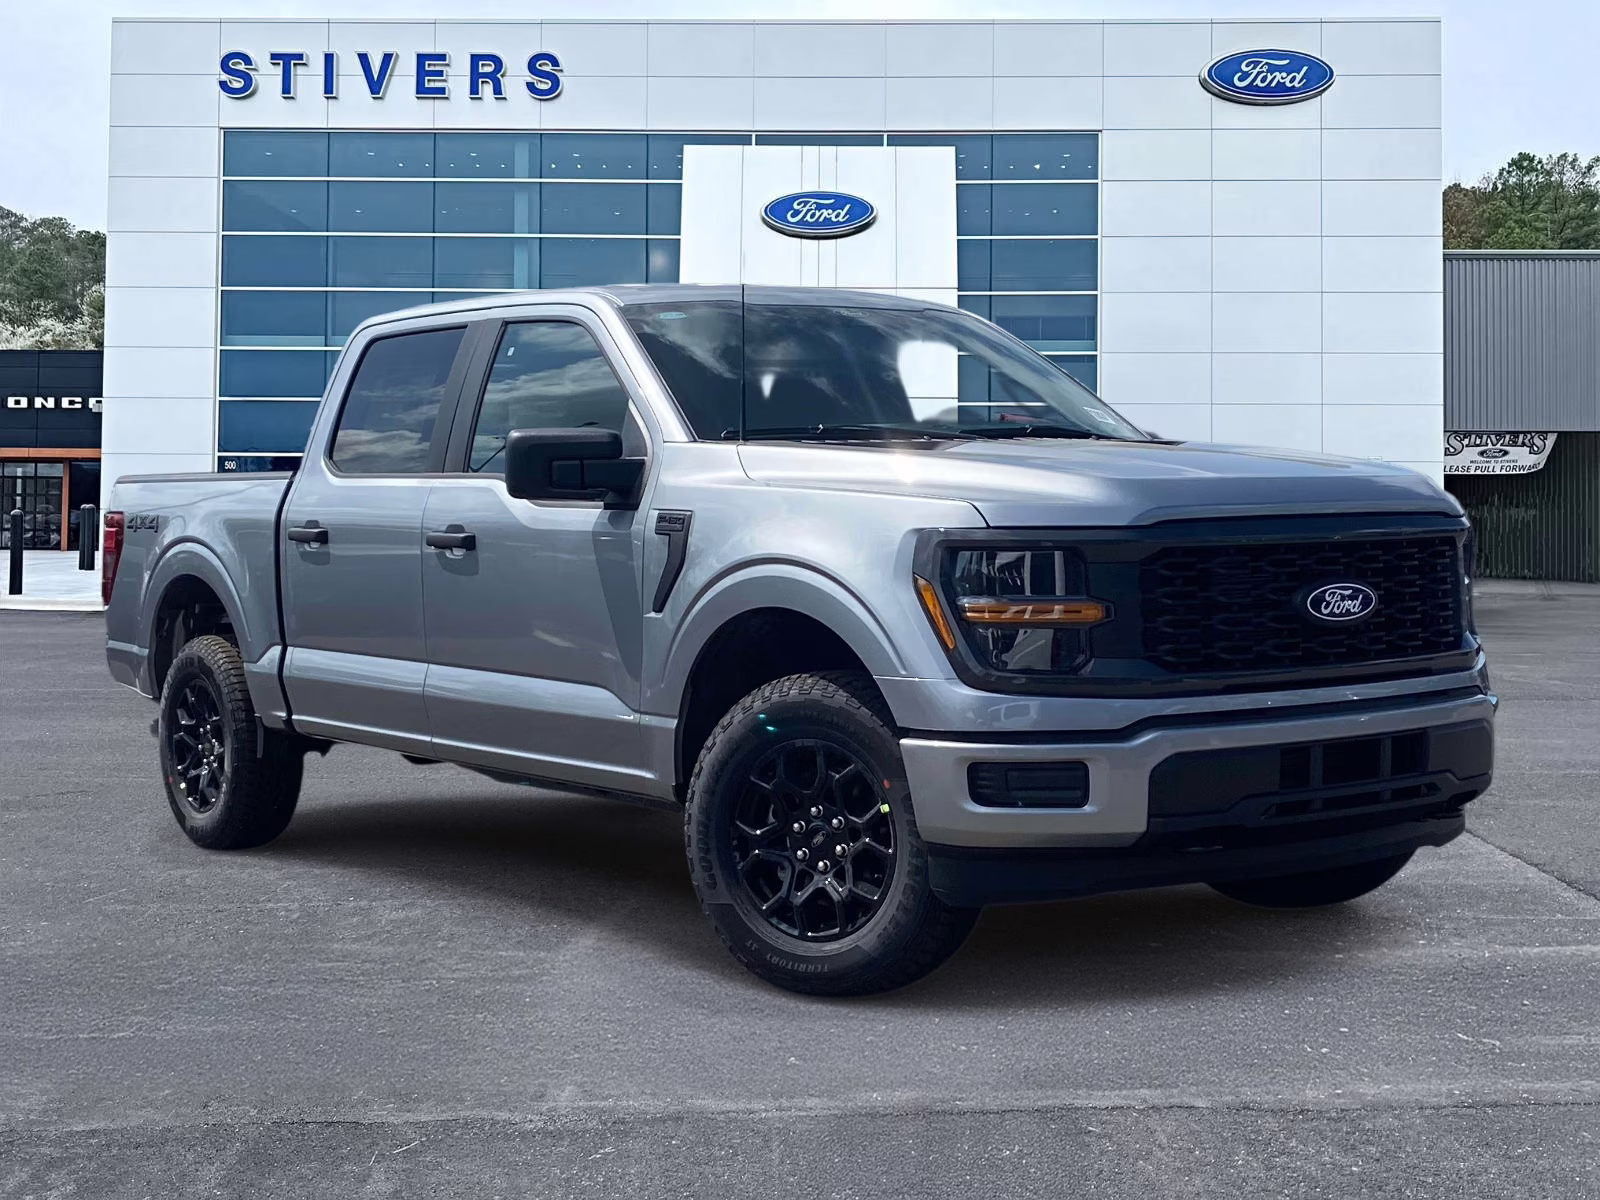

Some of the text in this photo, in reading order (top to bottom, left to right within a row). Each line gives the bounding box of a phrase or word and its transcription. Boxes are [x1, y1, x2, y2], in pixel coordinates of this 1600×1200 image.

[218, 50, 564, 100] STIVERS
[1233, 58, 1308, 88] Ford
[786, 198, 851, 222] Ford
[1444, 432, 1547, 455] STIVERS
[224, 460, 237, 470] 500
[1474, 465, 1497, 473] PULL
[1321, 589, 1363, 614] Ford
